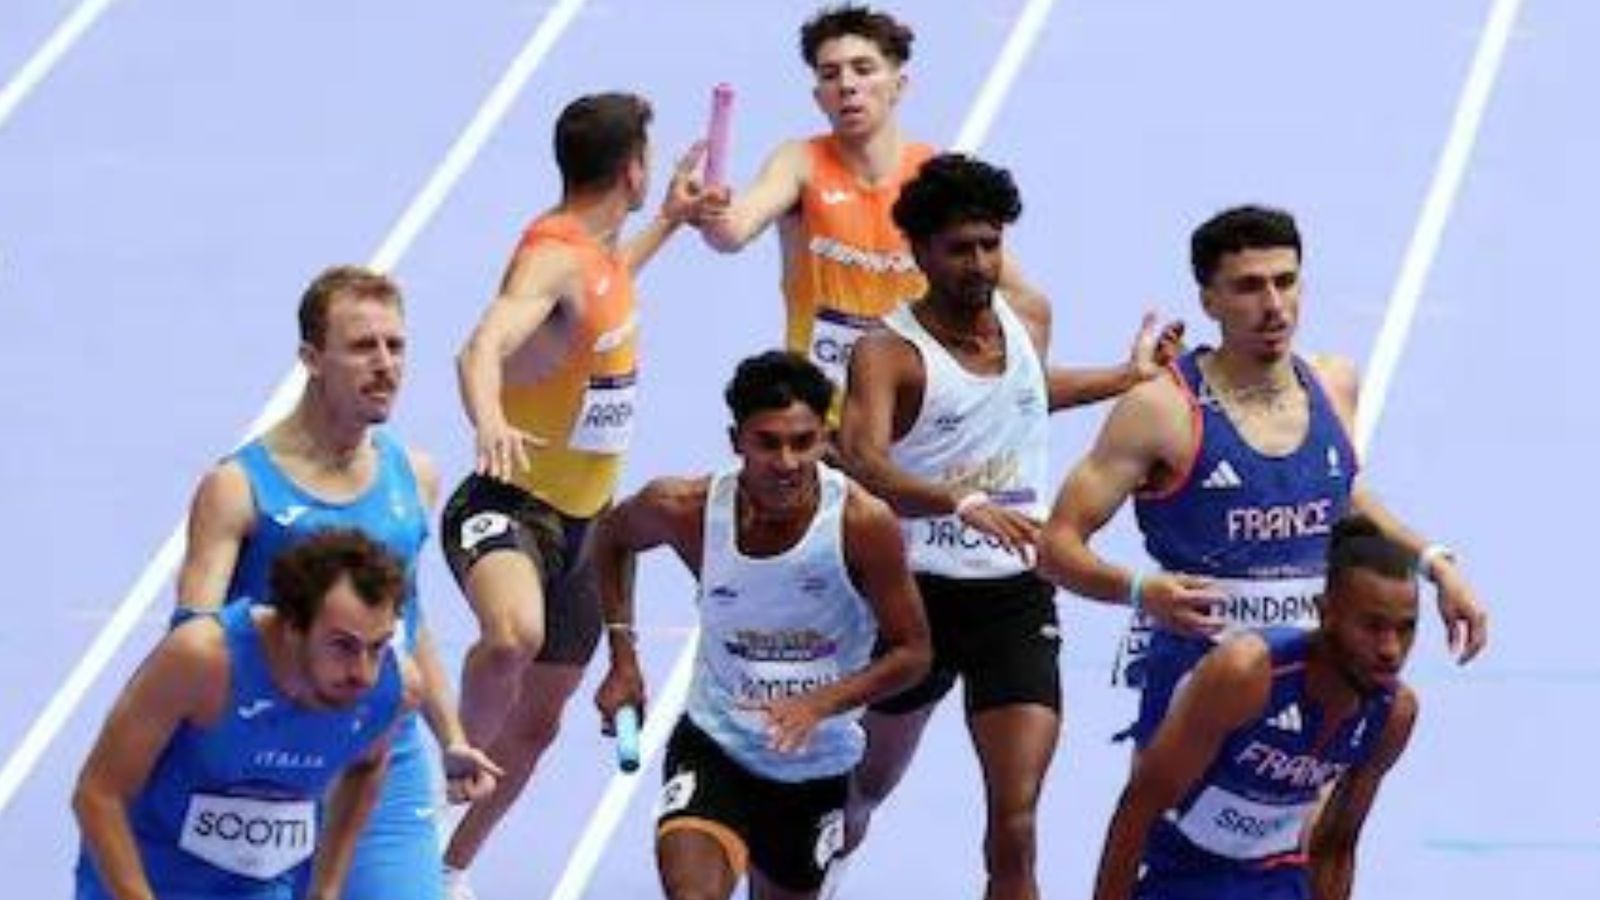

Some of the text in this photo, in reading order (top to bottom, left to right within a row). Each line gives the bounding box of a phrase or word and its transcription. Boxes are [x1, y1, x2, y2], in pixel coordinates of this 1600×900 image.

[1228, 500, 1332, 541] FRANCE
[253, 752, 325, 767] ITALIA
[194, 812, 307, 848] SCOTTI
